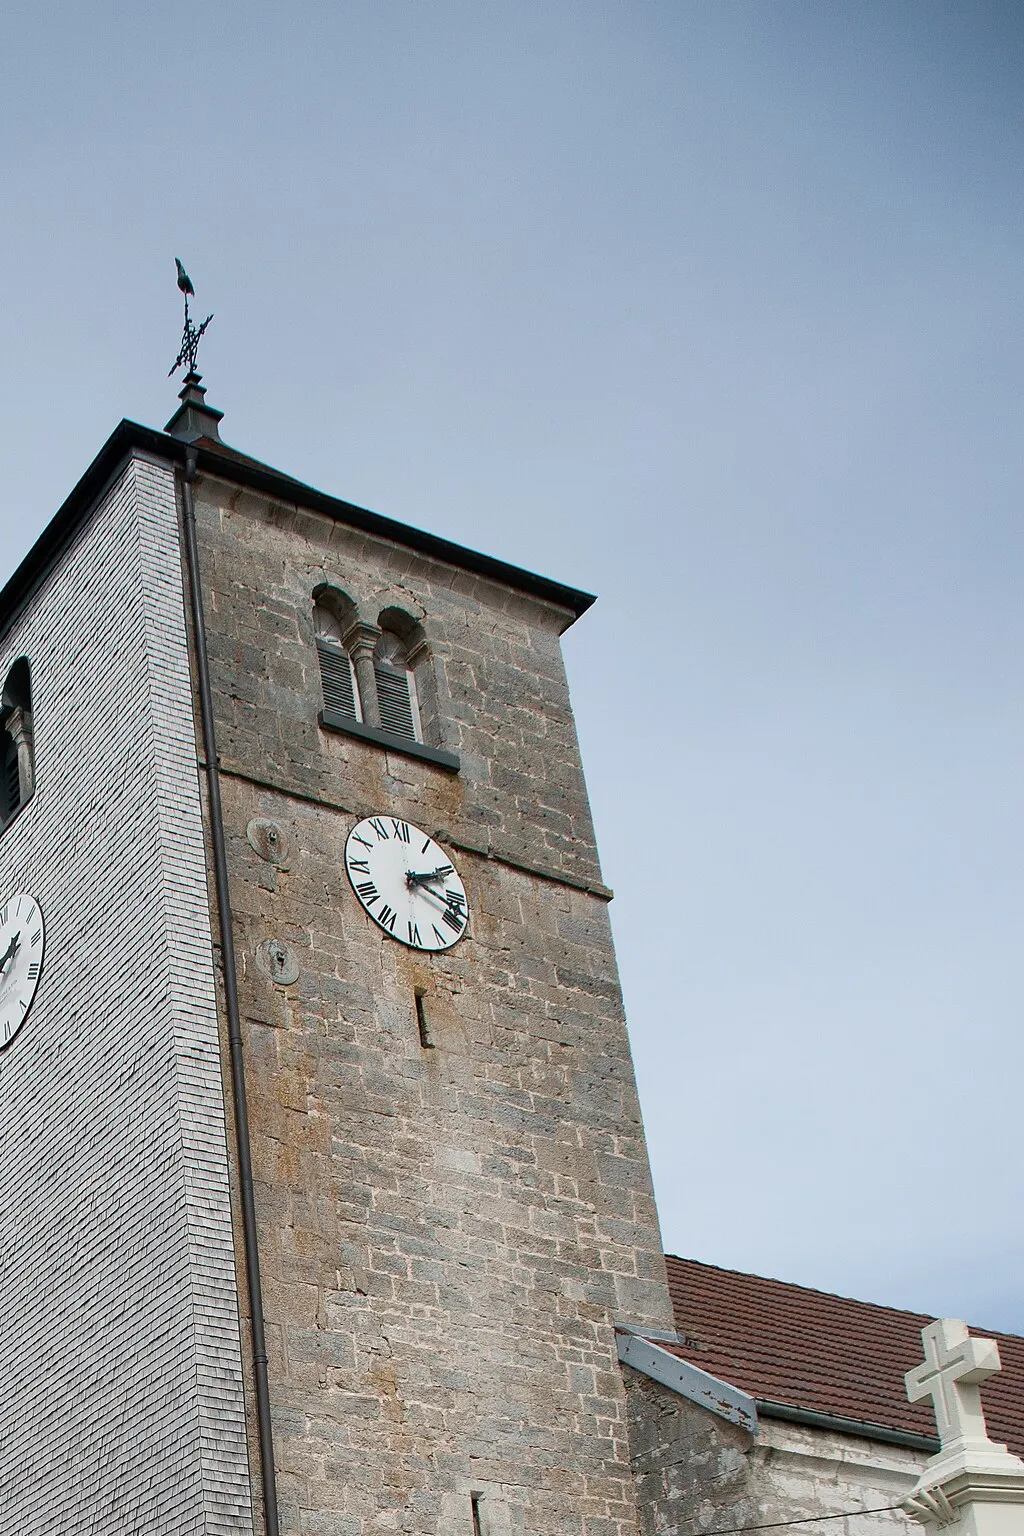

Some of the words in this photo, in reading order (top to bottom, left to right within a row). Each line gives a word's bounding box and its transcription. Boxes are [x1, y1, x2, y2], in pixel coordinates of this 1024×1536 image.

[368, 818, 389, 841] XI
[392, 819, 410, 843] XII
[352, 832, 373, 852] X
[422, 839, 430, 854] I
[349, 856, 370, 874] IX
[356, 882, 380, 906] VIII
[378, 905, 397, 931] VII
[408, 921, 422, 945] VI
[432, 924, 446, 946] V
[20, 1000, 26, 1014] V
